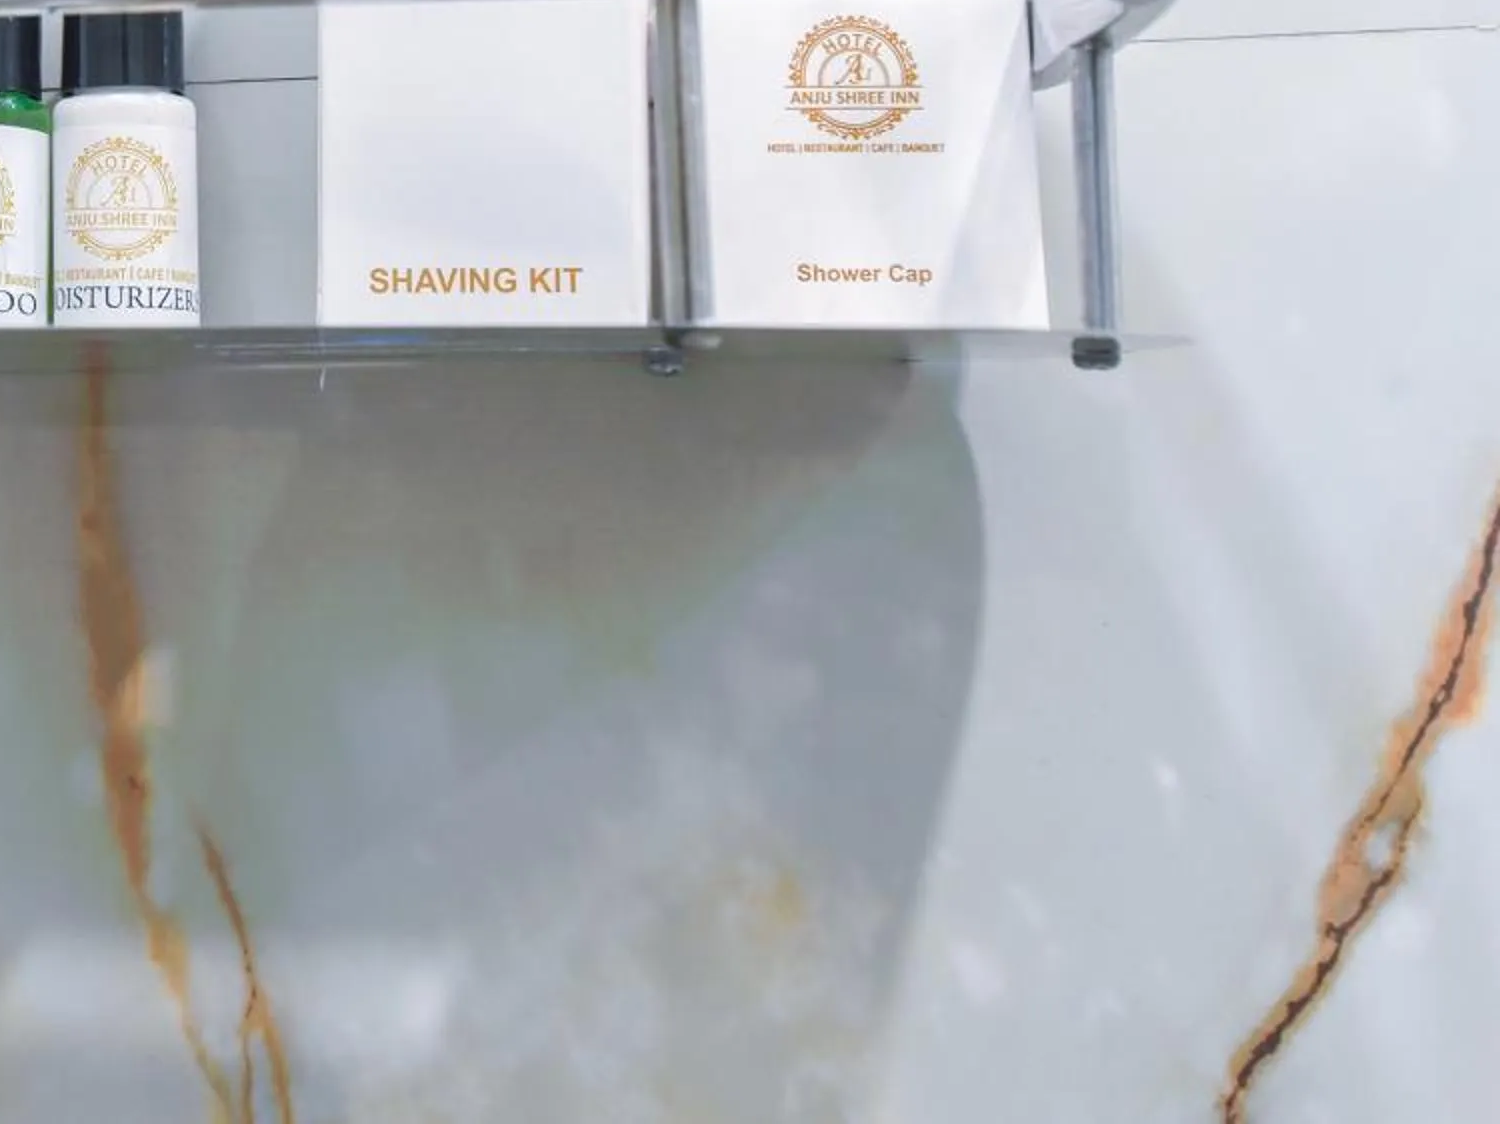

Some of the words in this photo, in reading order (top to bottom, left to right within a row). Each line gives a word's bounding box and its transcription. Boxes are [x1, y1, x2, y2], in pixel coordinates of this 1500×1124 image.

[821, 33, 884, 58] HOTEL
[790, 90, 832, 105] ANJU
[836, 90, 885, 105] SHREE
[890, 90, 920, 105] INN
[92, 155, 149, 176] HOTEL
[99, 211, 149, 226] SHREE
[152, 212, 177, 227] INN
[369, 267, 518, 294] SHAVING
[529, 267, 584, 294] KIT
[796, 263, 882, 283] Shower
[889, 263, 933, 286] Cap
